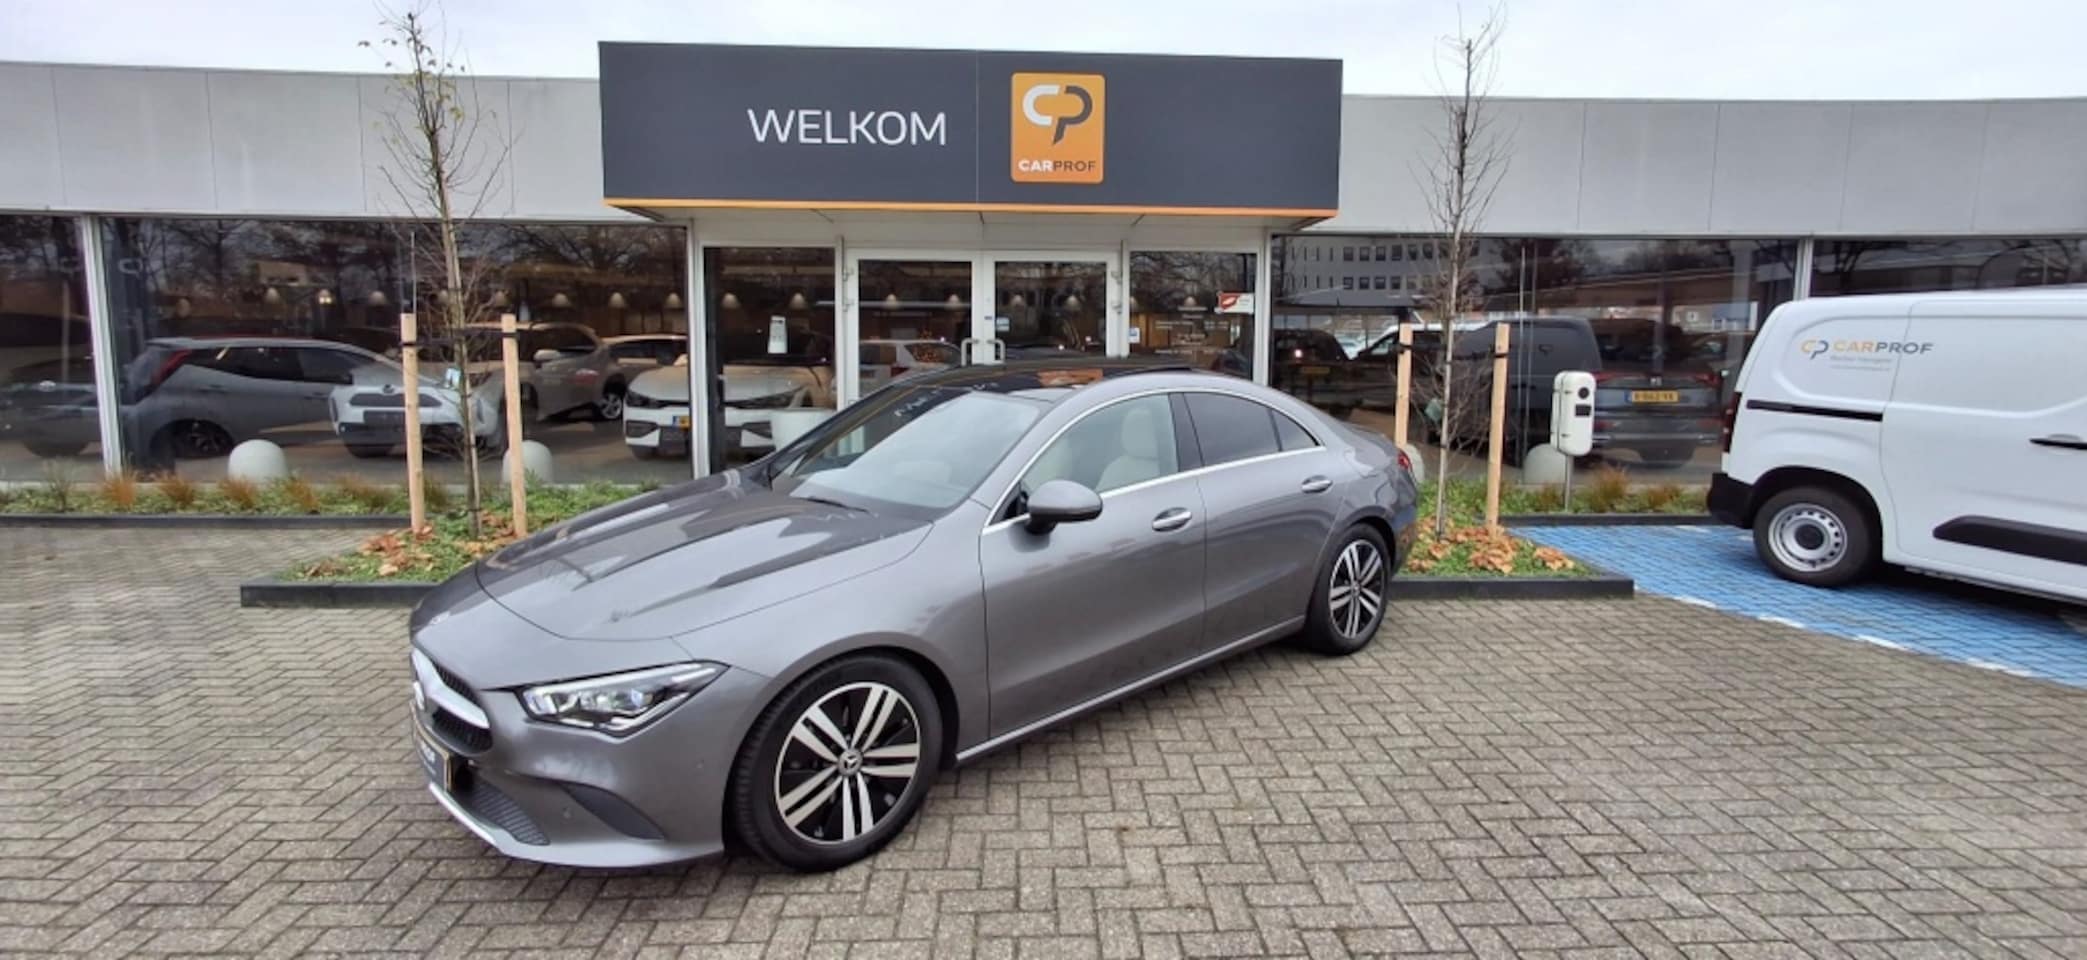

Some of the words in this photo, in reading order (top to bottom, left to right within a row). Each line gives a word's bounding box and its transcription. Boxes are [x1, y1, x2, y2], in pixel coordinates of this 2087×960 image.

[747, 108, 947, 146] WELKOM
[1018, 159, 1096, 172] CARPROF
[1833, 340, 1934, 355] CARPROF
